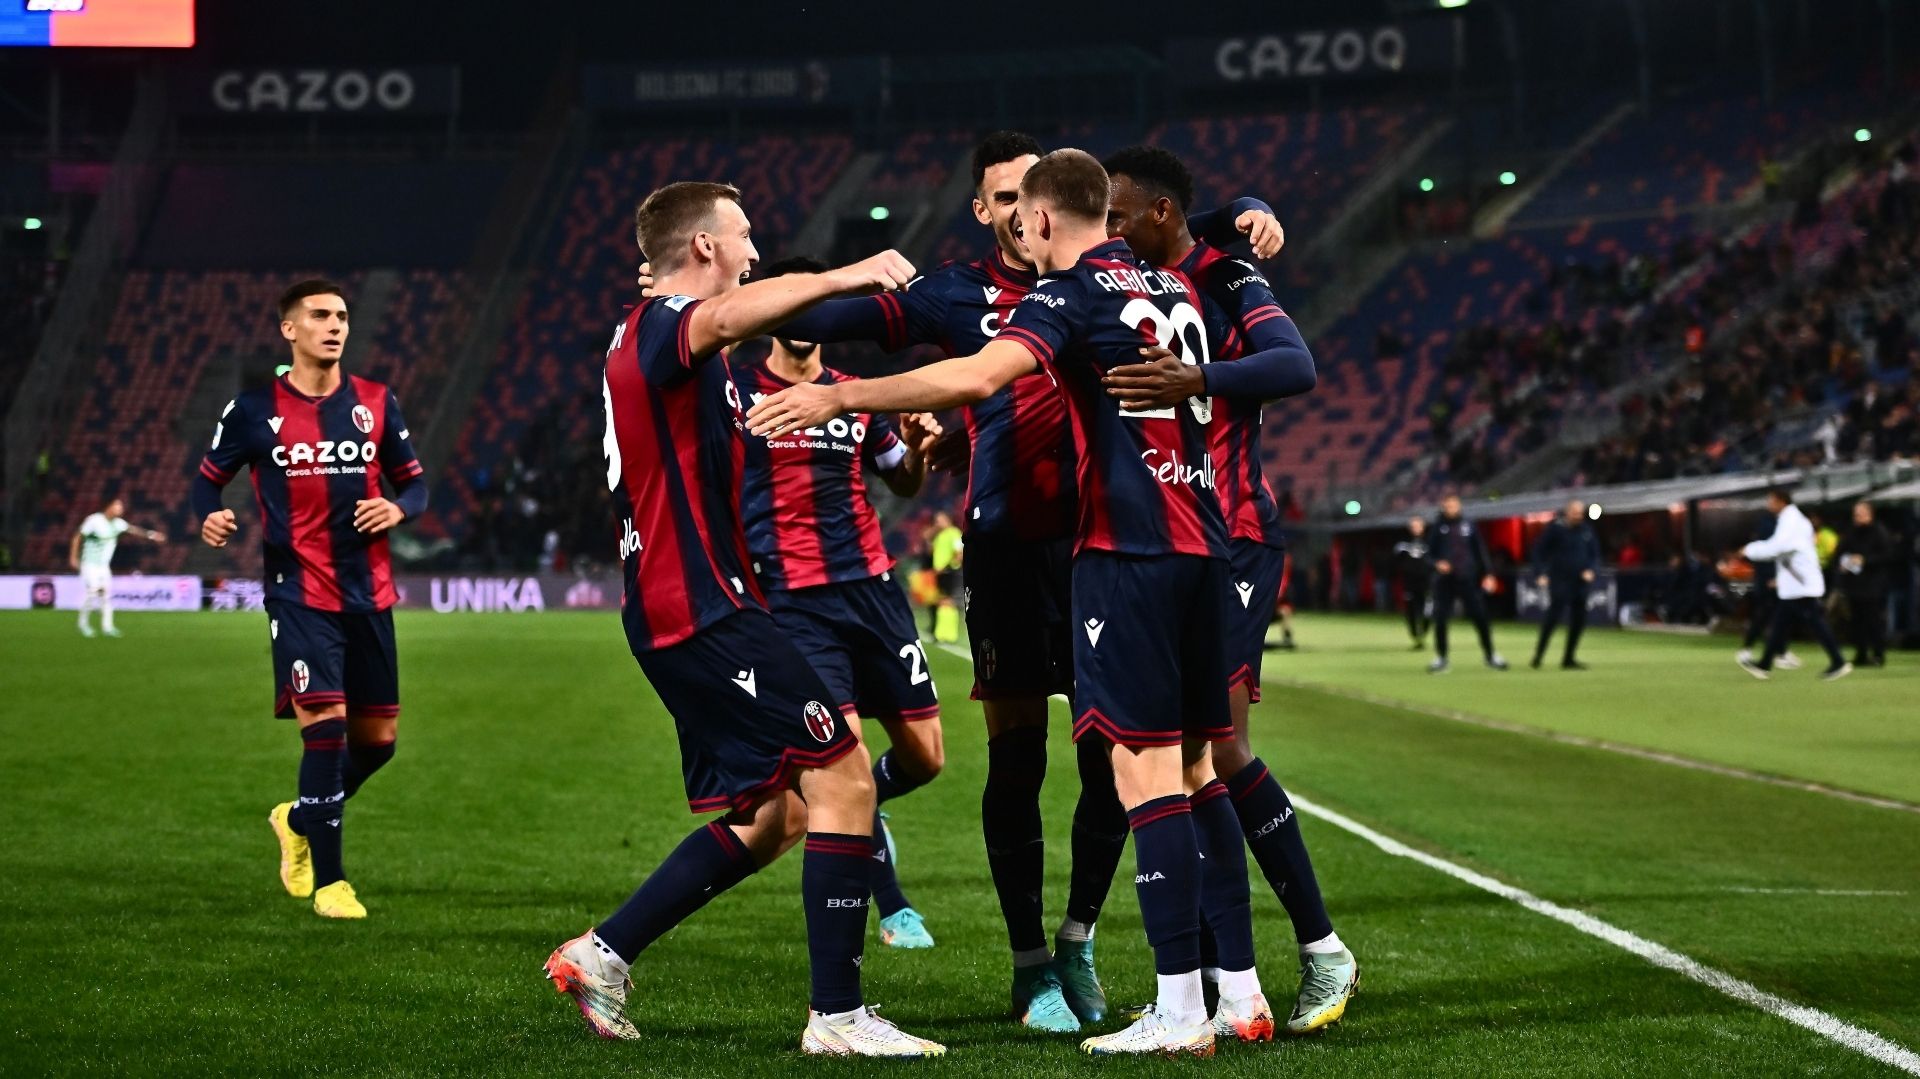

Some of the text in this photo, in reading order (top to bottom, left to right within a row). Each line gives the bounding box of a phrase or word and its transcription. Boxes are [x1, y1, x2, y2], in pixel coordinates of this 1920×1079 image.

[1215, 27, 1406, 81] CAZOO
[213, 71, 414, 111] CAZOO
[1119, 298, 1212, 424] 20
[271, 440, 377, 467] CAZOO
[767, 440, 798, 449] Cerca.
[799, 440, 830, 449] Guida.
[430, 577, 545, 613] UNIKA
